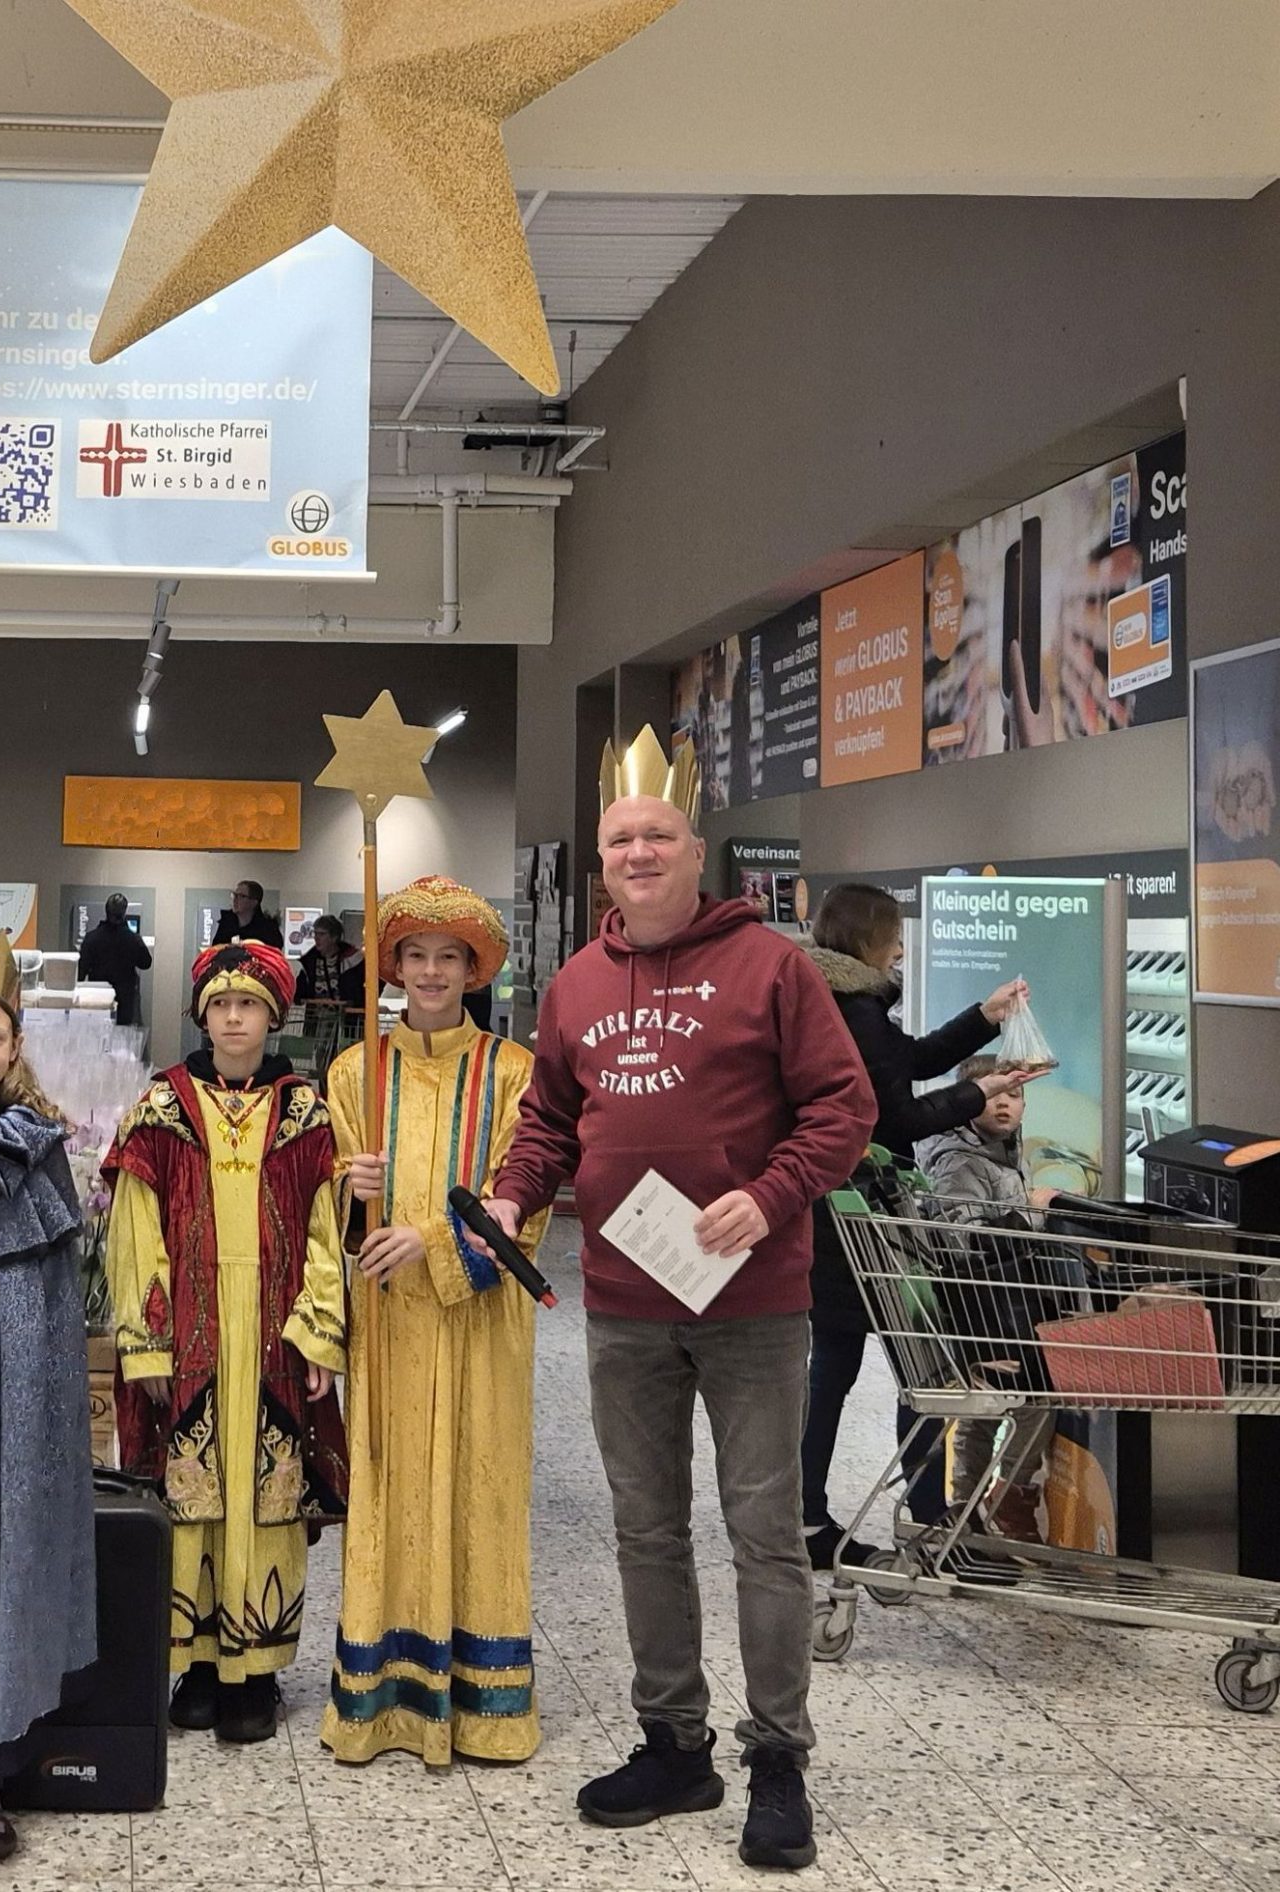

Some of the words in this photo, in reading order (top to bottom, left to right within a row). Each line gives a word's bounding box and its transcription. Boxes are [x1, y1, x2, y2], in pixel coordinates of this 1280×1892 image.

[28, 309, 60, 330] zu
[67, 306, 99, 331] de
[130, 423, 215, 439] Katholische
[220, 422, 268, 439] Pfarrei
[156, 447, 177, 463] St.
[183, 447, 232, 467] Birgid
[271, 540, 348, 558] GLOBUS
[835, 607, 857, 632] Jetzt
[858, 626, 908, 670] GLOBUS
[834, 694, 845, 722] &
[846, 676, 903, 721] PAYBACK
[834, 727, 885, 757] verknüpfen!
[1136, 871, 1177, 900] sparen!
[932, 889, 1010, 916] Kleingeld
[1015, 895, 1089, 919] gegen
[201, 908, 214, 946] Leergut
[932, 918, 1018, 941] Gutschein
[582, 1008, 704, 1049] VIELFALT
[631, 1034, 647, 1048] ist
[617, 1052, 659, 1065] unsere
[599, 1064, 685, 1096] STÄRKE!
[52, 1765, 97, 1776] SIRUS
